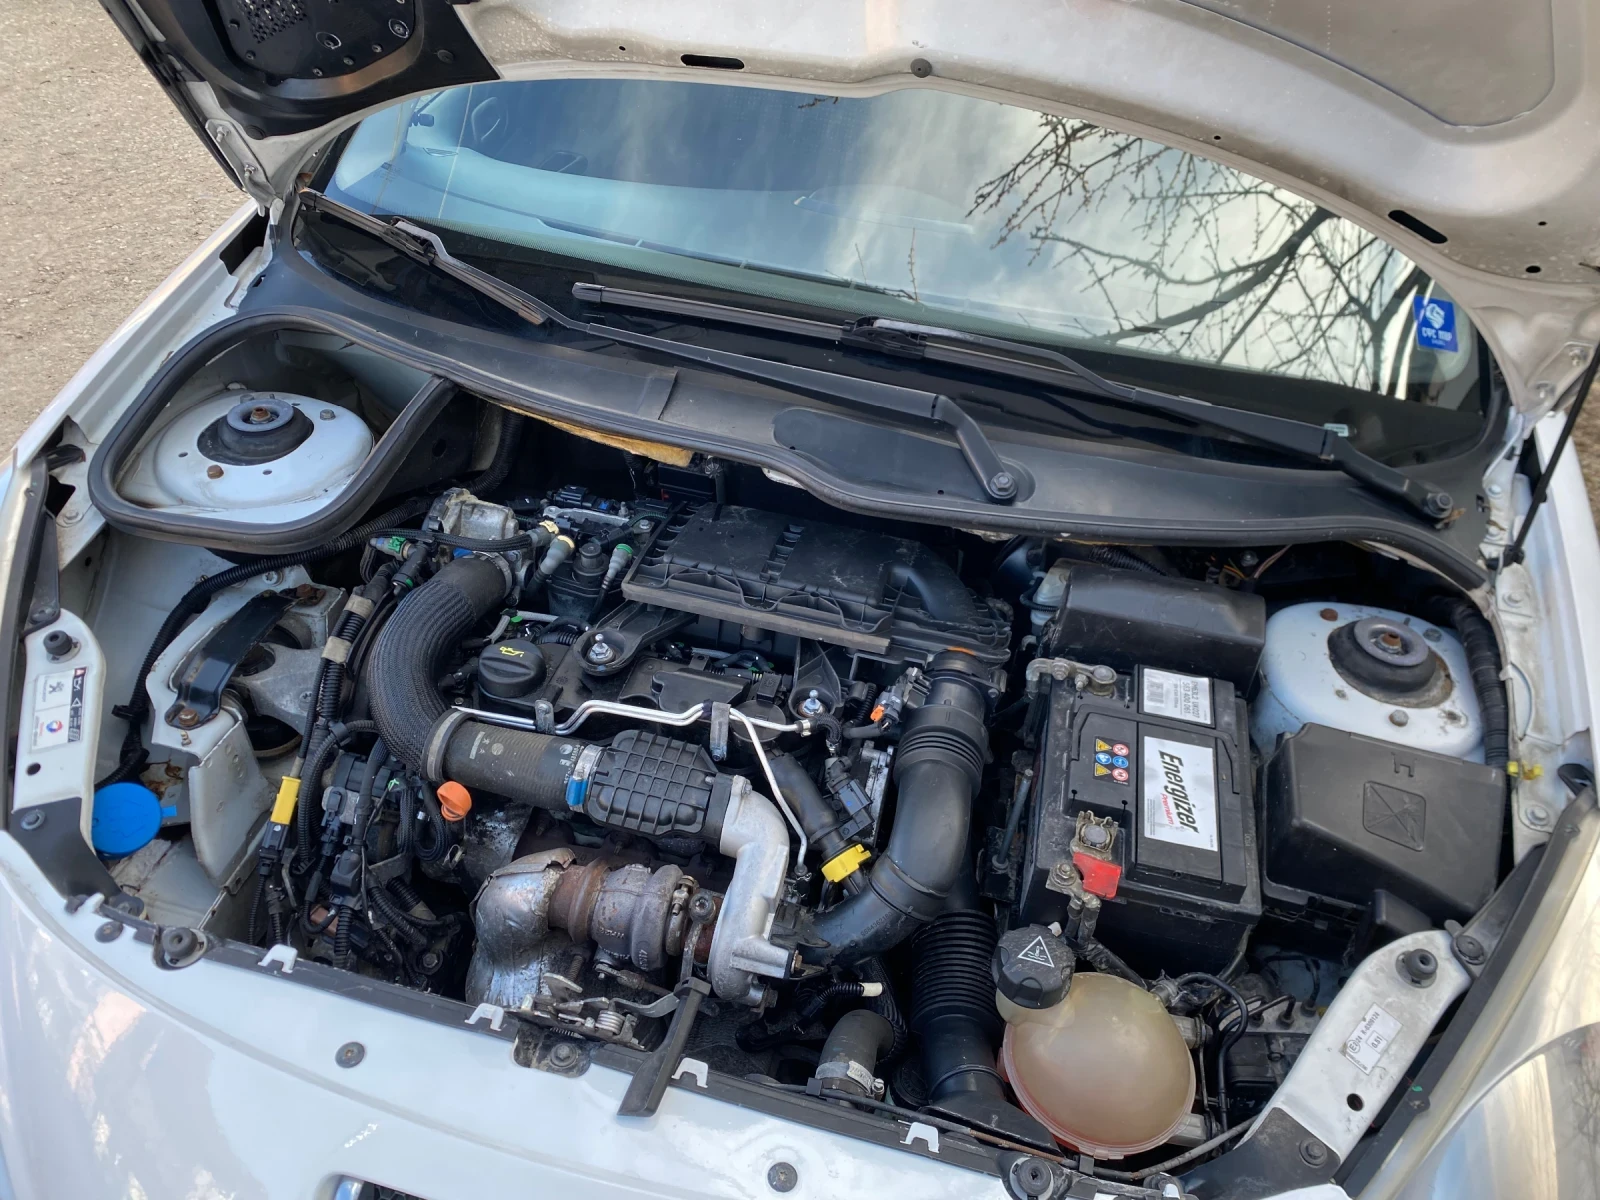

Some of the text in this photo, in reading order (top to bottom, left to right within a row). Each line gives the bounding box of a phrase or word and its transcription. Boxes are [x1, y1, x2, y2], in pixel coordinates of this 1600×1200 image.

[1183, 693, 1191, 704] 400
[1158, 750, 1200, 834] Energizer
[1160, 793, 1174, 825] Premium
[1371, 1036, 1382, 1048] 0.51
